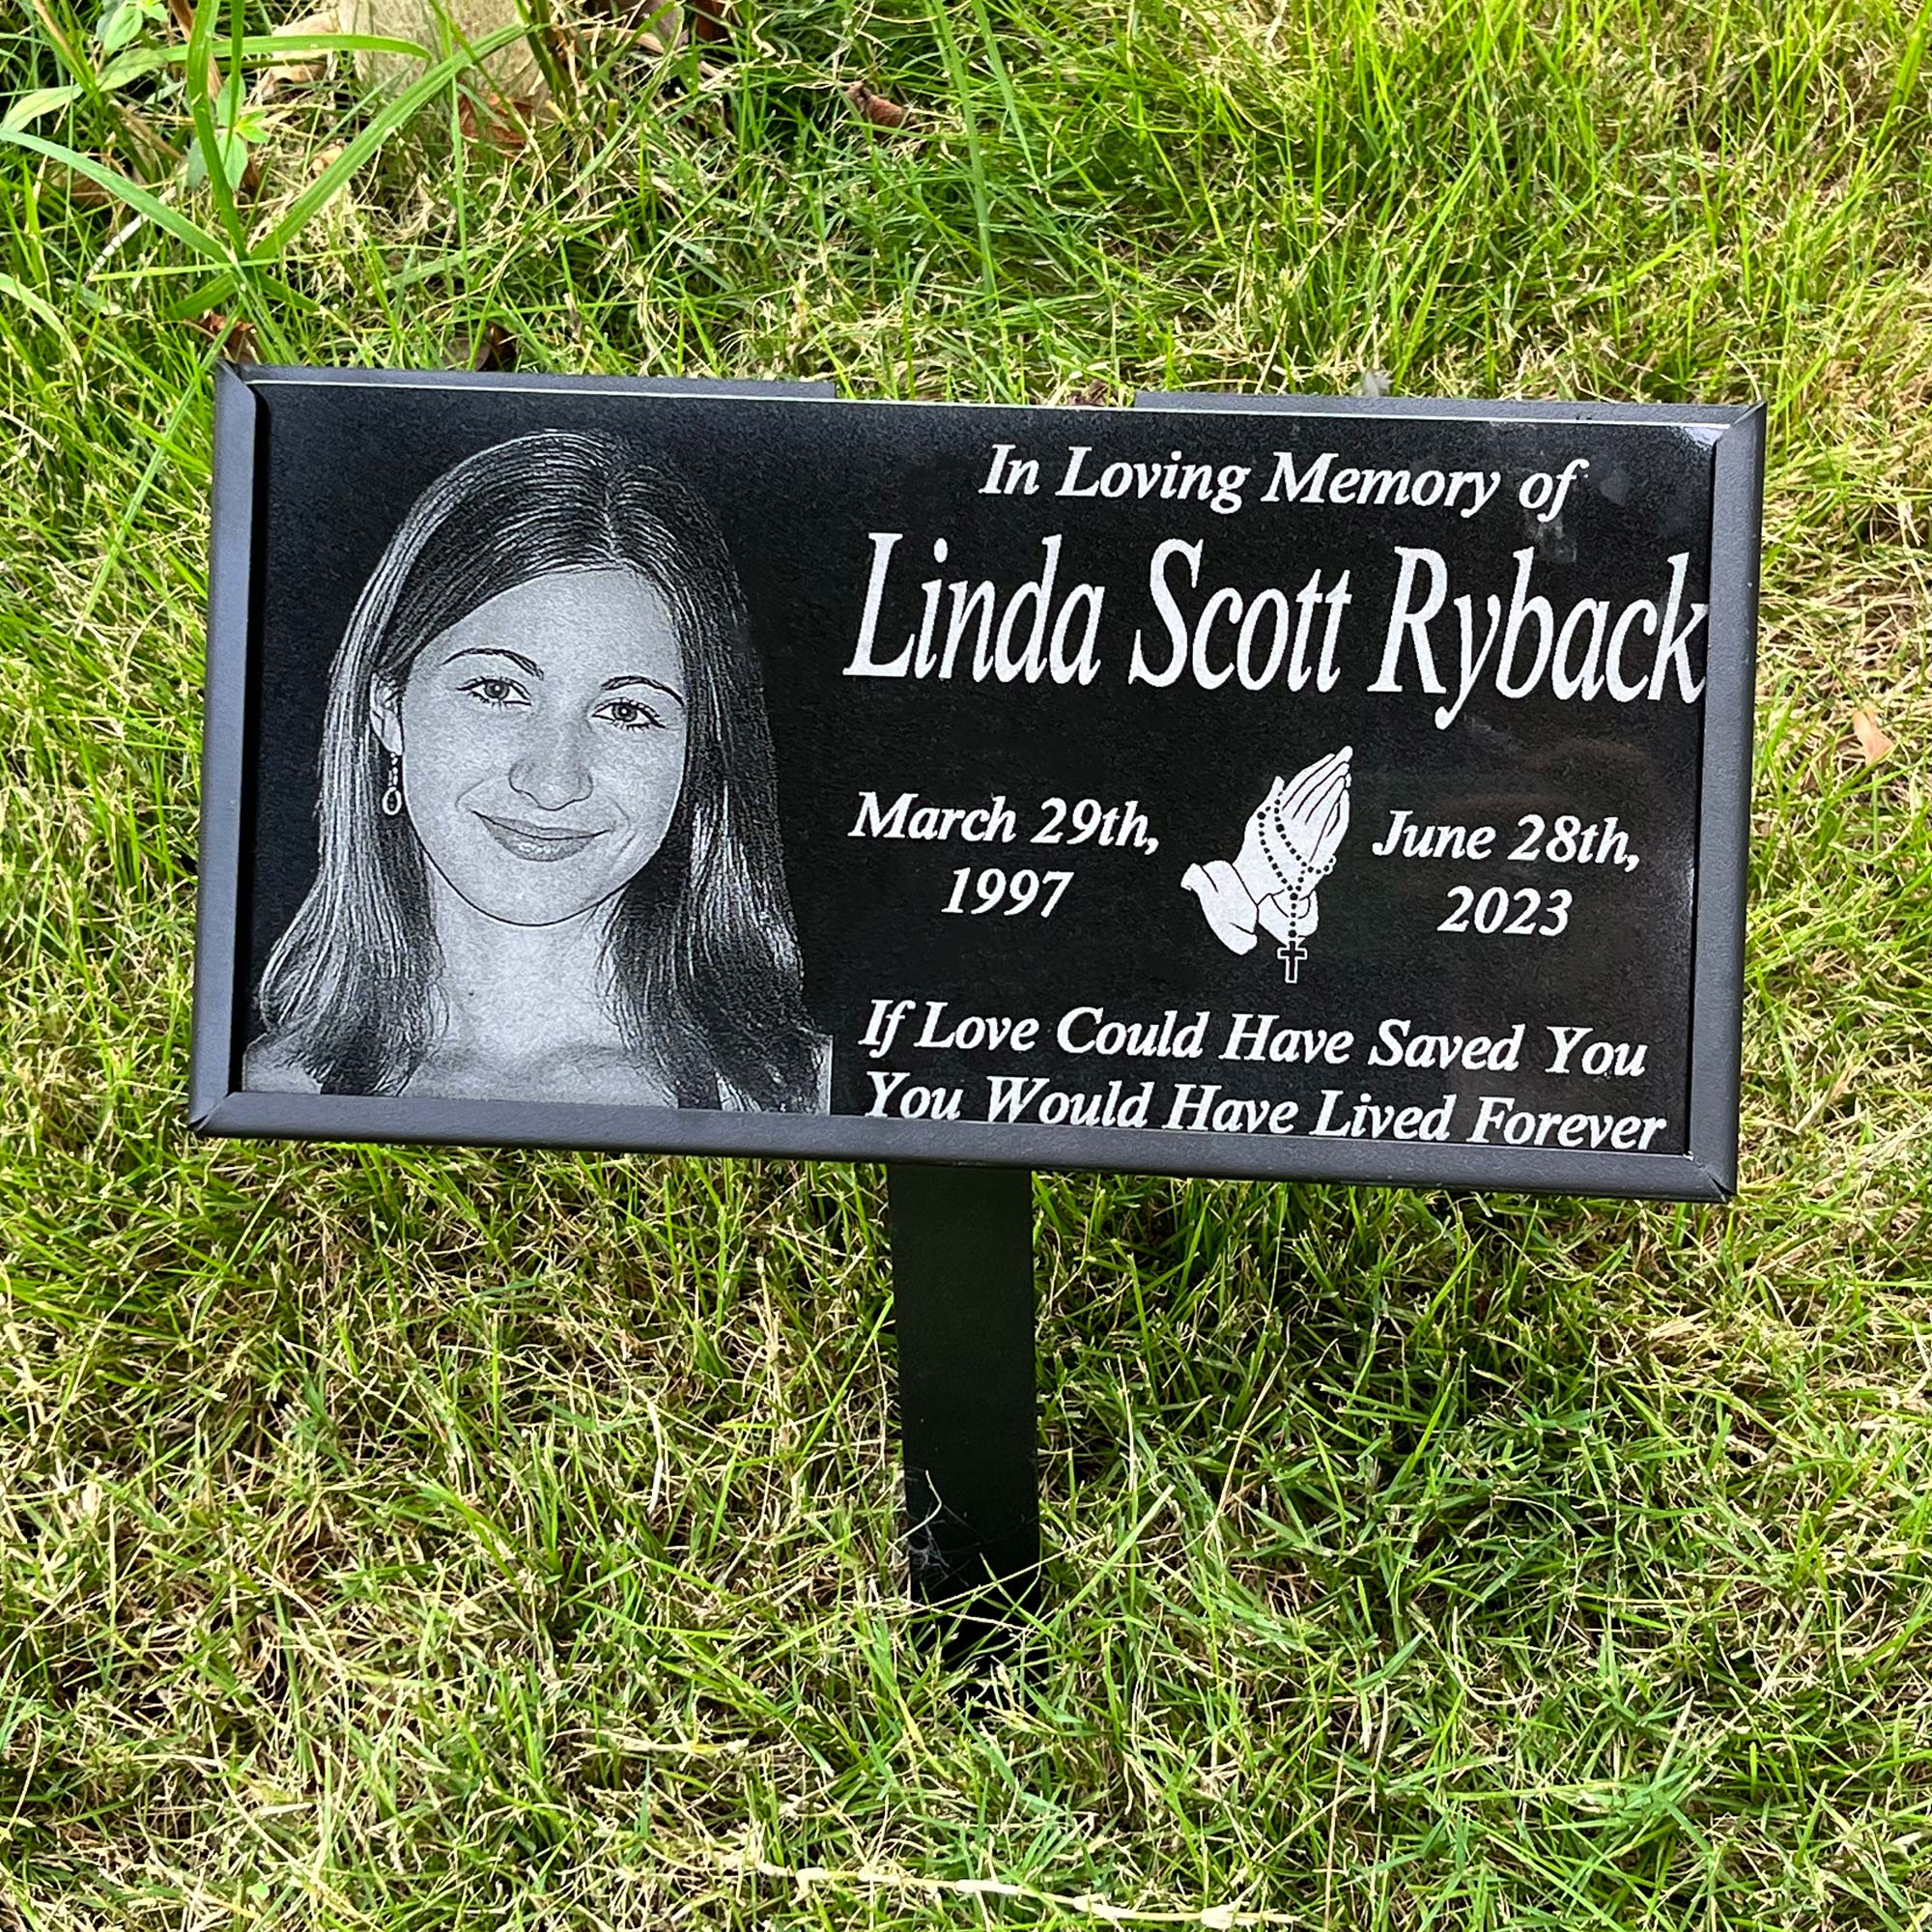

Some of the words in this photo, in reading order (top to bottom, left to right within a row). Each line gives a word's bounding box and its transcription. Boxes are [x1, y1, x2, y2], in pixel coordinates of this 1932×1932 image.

[978, 443, 1039, 495] In
[1054, 446, 1252, 515] Loving
[1260, 452, 1500, 519] Memory
[1519, 458, 1590, 524] of
[842, 532, 1106, 686] Linda
[1128, 538, 1352, 693] Scott
[1366, 546, 1710, 730] Ryback
[847, 792, 1017, 843] March
[1029, 797, 1159, 855] 29th,
[1372, 810, 1496, 860] June
[1506, 814, 1640, 873] 28th,
[941, 867, 1074, 918] 1997
[1436, 885, 1573, 937] 2023
[857, 999, 917, 1058] If
[914, 1001, 1039, 1052] Love
[1056, 1007, 1211, 1059] Could
[1217, 1013, 1354, 1065] Have
[1367, 1019, 1526, 1071] Saved
[1545, 1025, 1648, 1077] You
[864, 1070, 964, 1122] You
[984, 1076, 1155, 1128] Would
[1159, 1084, 1299, 1134] Have
[1309, 1090, 1458, 1142] Lived
[1465, 1095, 1667, 1151] Forever
